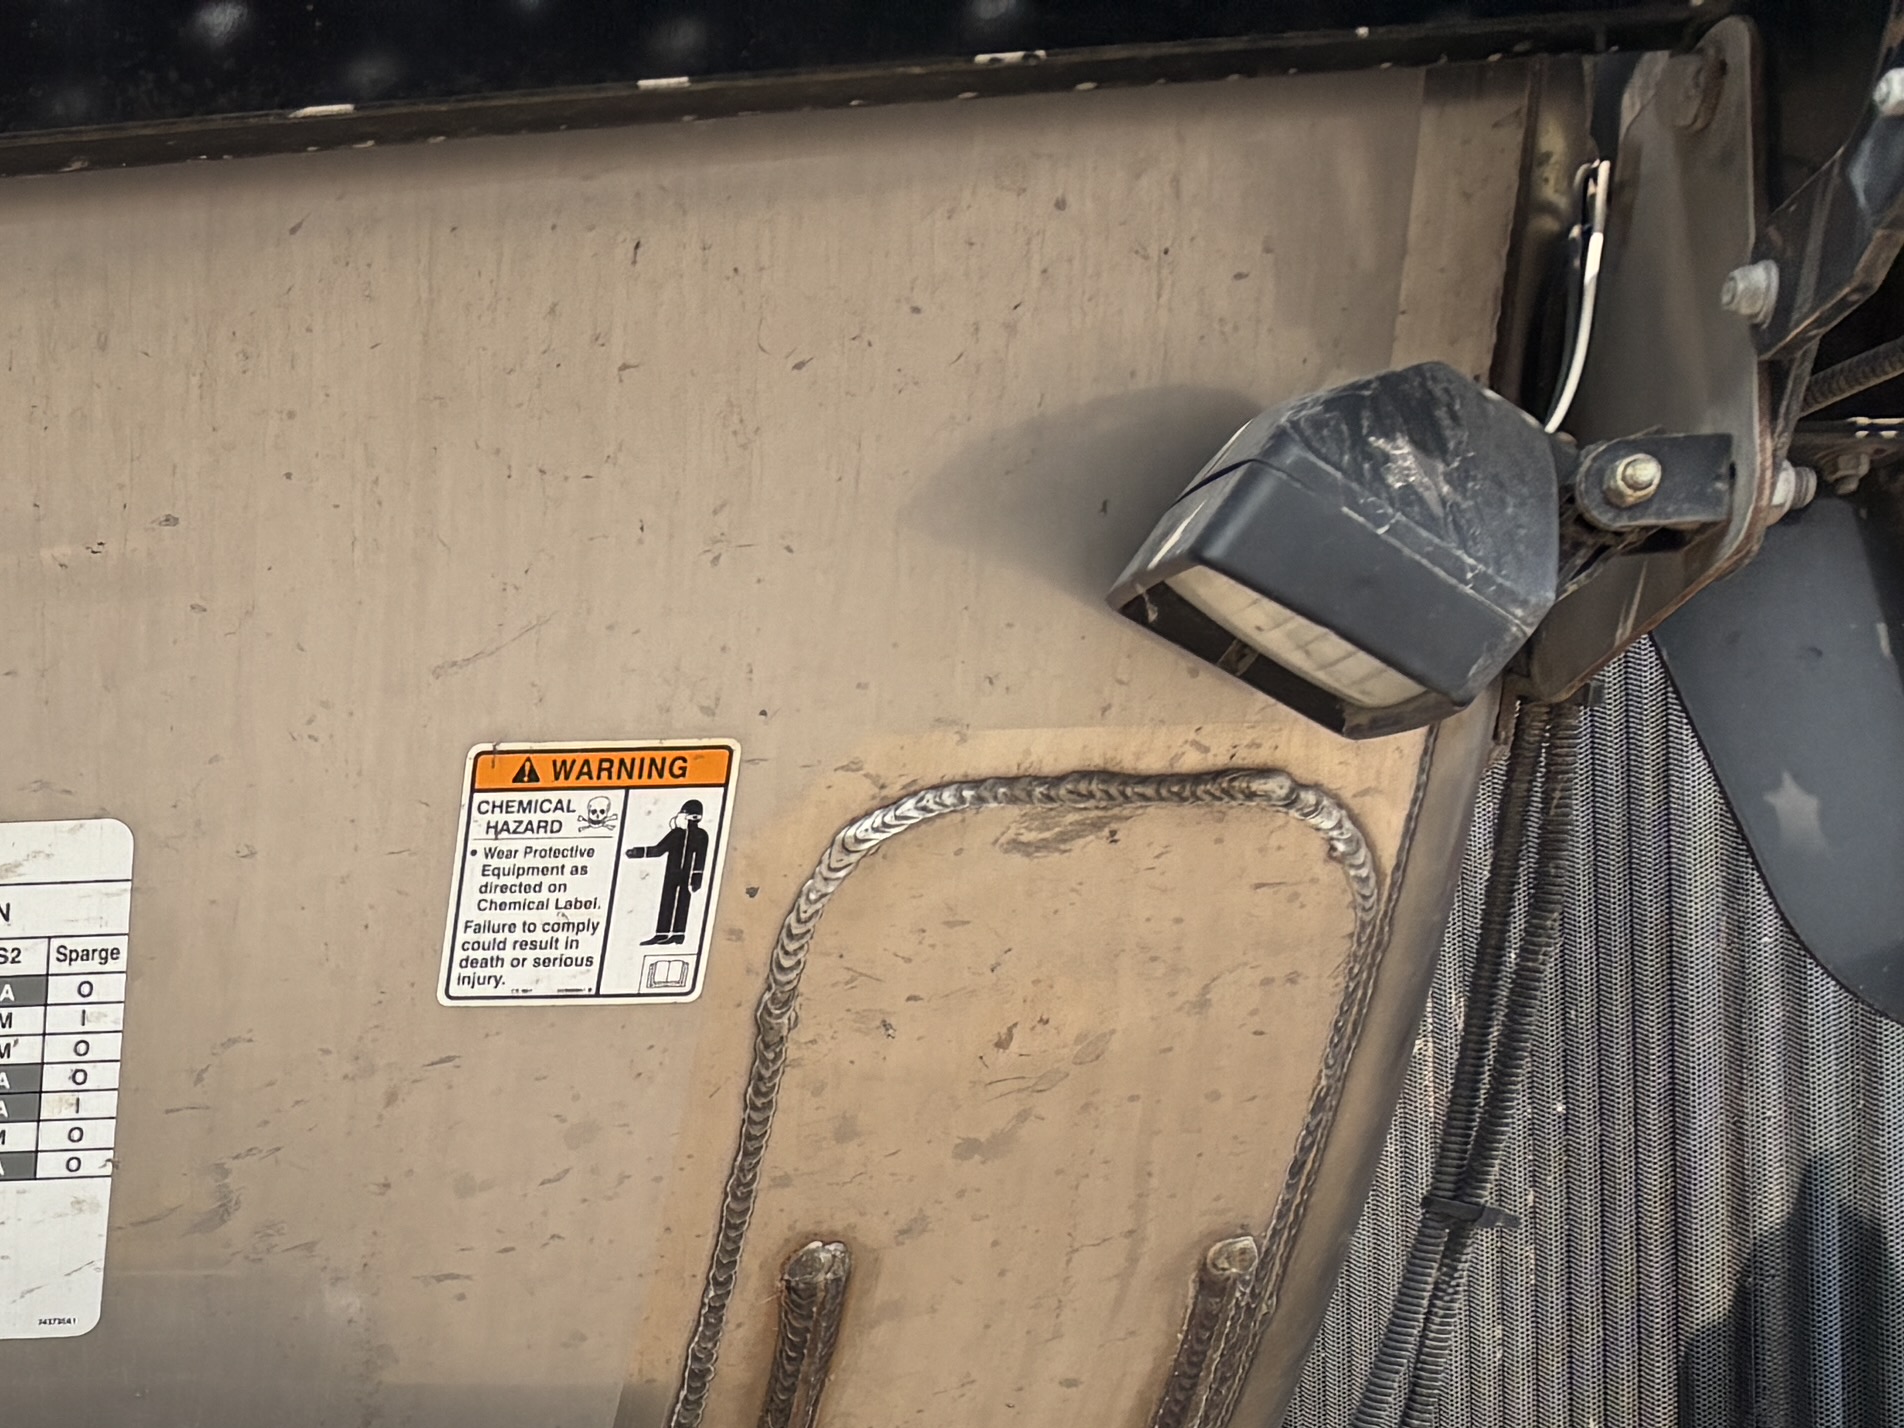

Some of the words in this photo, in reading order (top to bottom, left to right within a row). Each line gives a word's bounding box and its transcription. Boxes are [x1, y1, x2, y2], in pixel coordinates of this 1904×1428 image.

[553, 756, 687, 781] WARNING
[477, 799, 576, 814] CHEMICAL
[486, 820, 563, 835] HAZARD
[484, 847, 518, 859] Wear
[524, 845, 594, 858] Protective
[482, 864, 565, 879] Equipment
[570, 865, 587, 875] as
[479, 881, 542, 894] directed
[548, 883, 567, 893] on
[477, 898, 549, 911] Chemical
[555, 897, 600, 909] Label.
[464, 920, 516, 934] Failure
[523, 921, 536, 933] to
[542, 918, 599, 935] comply
[462, 938, 507, 951] could
[513, 936, 559, 950] result
[565, 936, 579, 949] in
[56, 945, 120, 966] Sparge
[459, 955, 504, 968] death
[511, 958, 527, 967] or
[533, 954, 593, 967] serious
[457, 972, 505, 989] injury.
